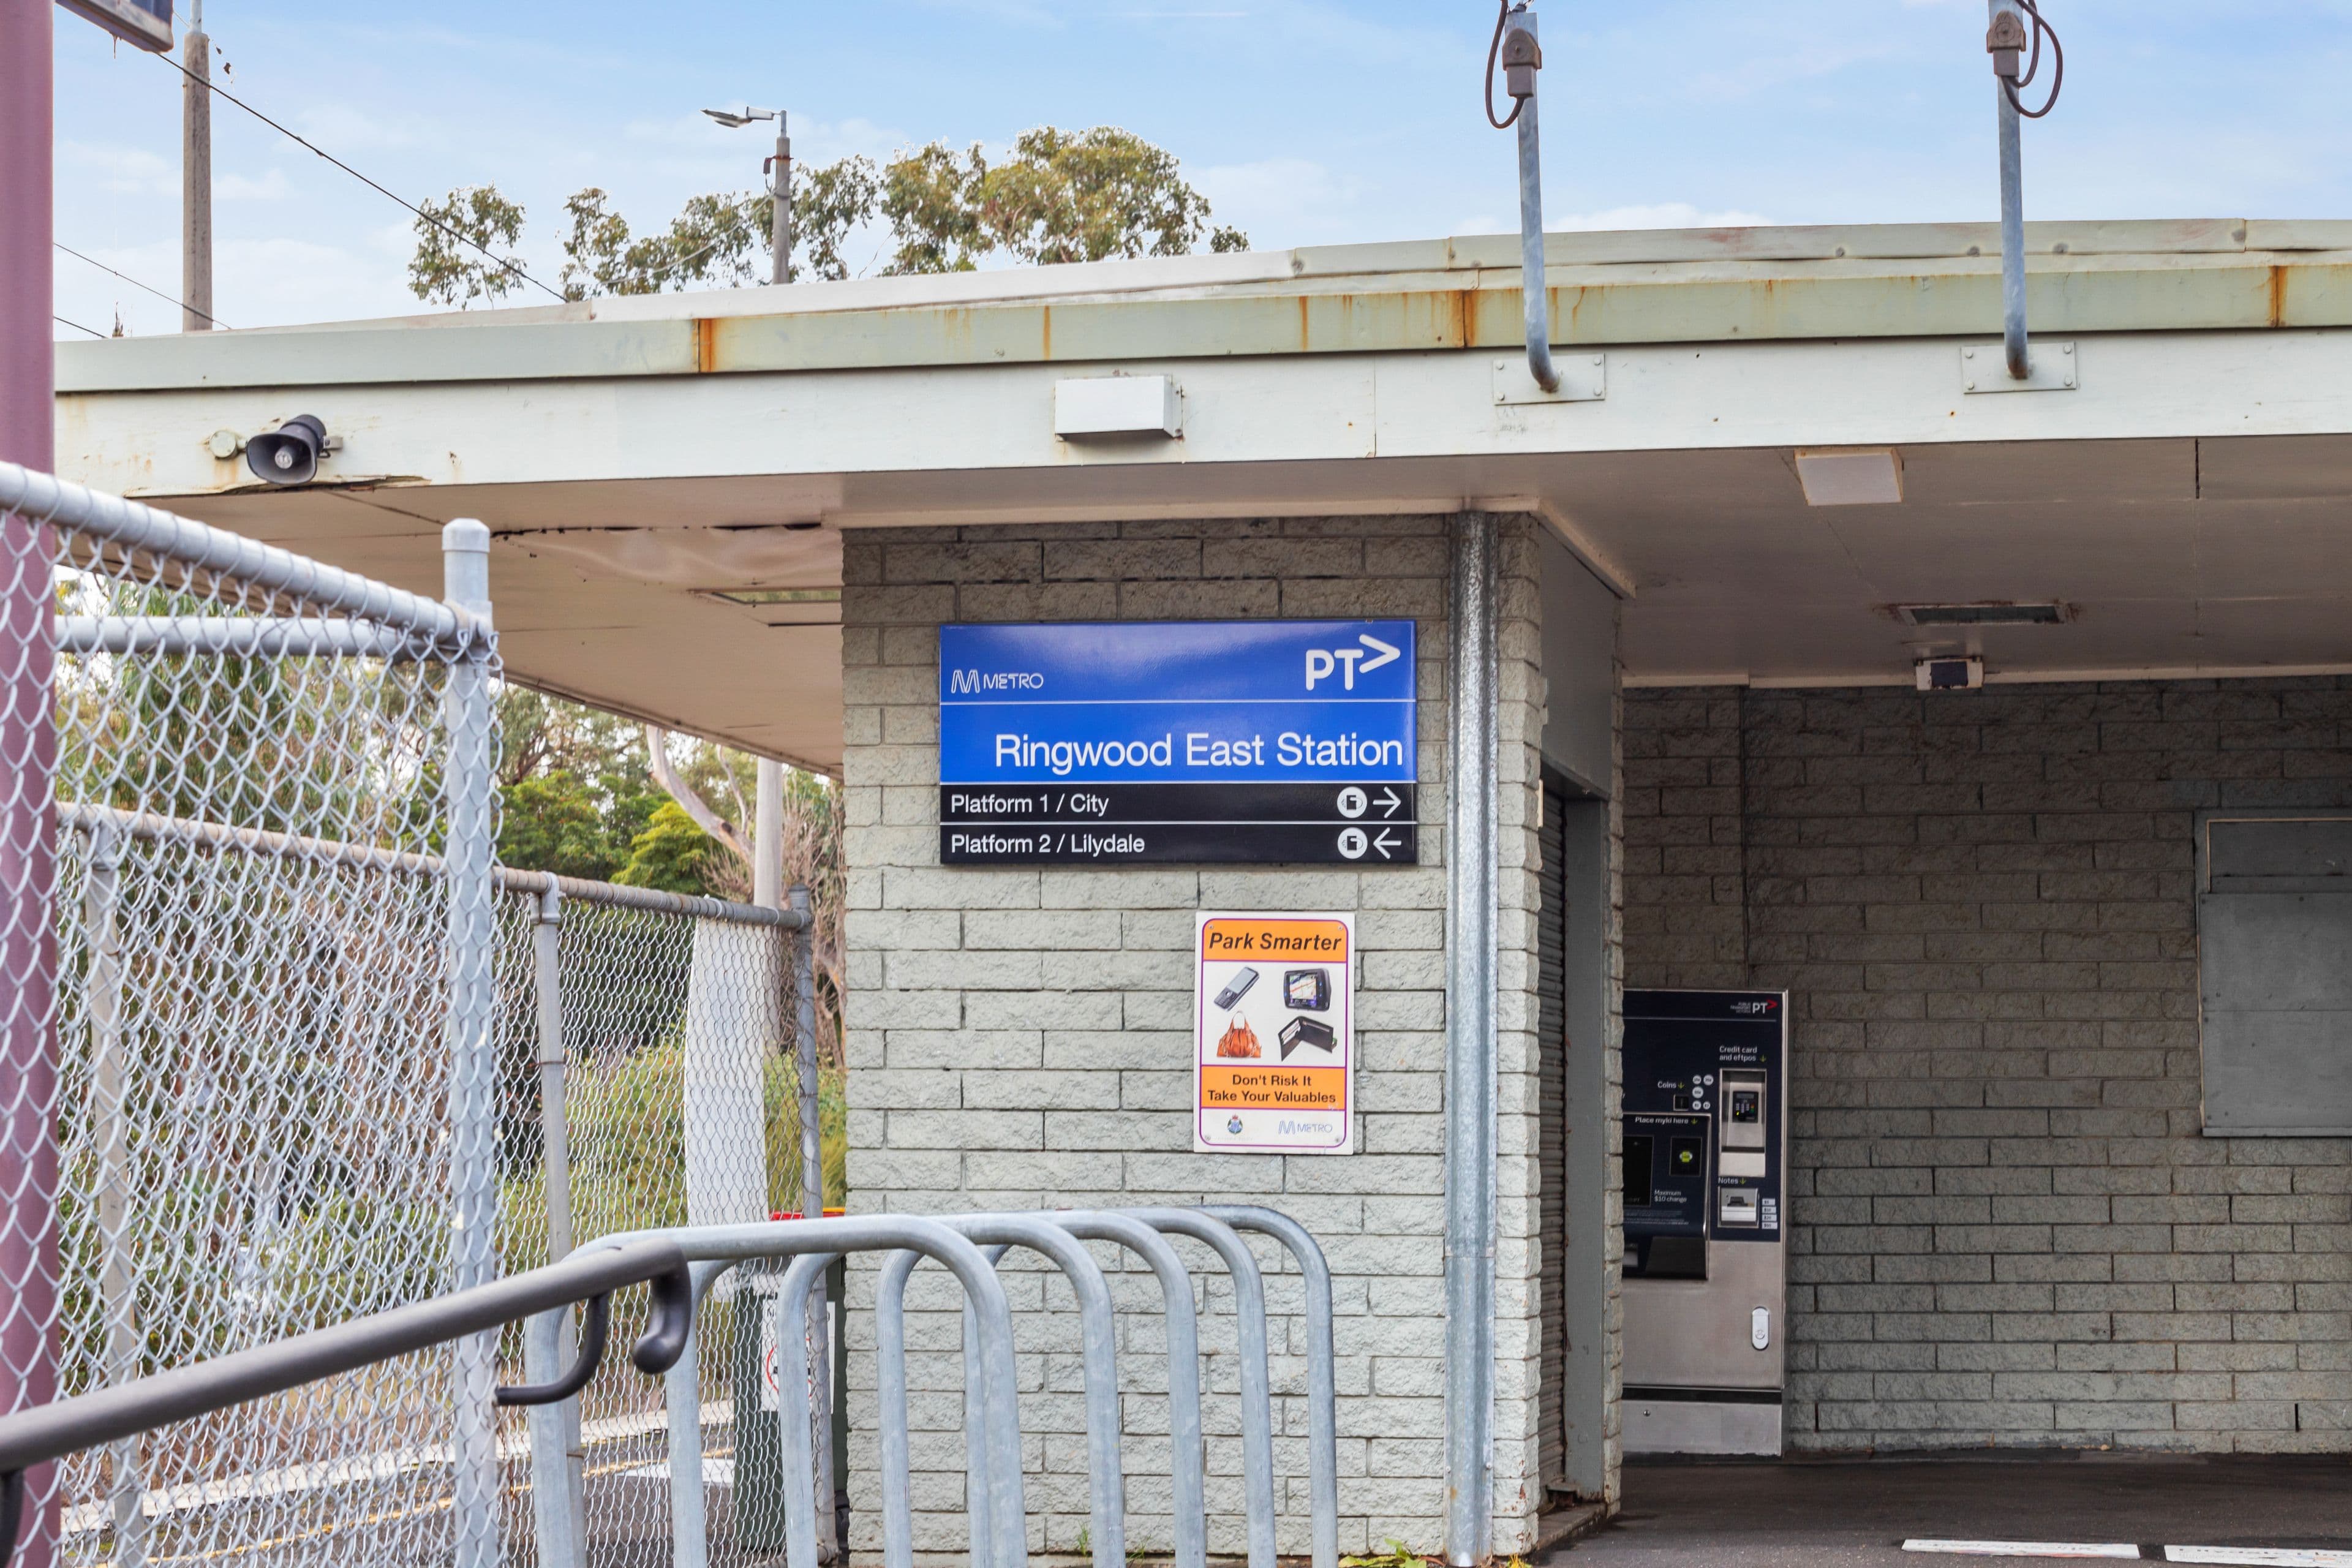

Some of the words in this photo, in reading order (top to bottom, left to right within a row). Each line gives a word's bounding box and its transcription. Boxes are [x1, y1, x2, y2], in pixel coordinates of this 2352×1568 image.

[982, 673, 1044, 689] METRO
[995, 733, 1172, 775] Ringwood
[1186, 732, 1265, 766] East
[1276, 731, 1403, 766] Station
[951, 794, 1033, 813] Platform
[1039, 794, 1047, 812] 1
[1055, 794, 1065, 813] /
[1071, 793, 1109, 816] City
[951, 834, 1033, 853] Platform
[1039, 834, 1051, 853] 2
[1056, 833, 1066, 853] /
[1071, 834, 1145, 857] Lilydale
[1209, 932, 1254, 950] Park
[1260, 933, 1341, 951] Smarter
[1733, 1054, 1757, 1063] eftpos
[1232, 1074, 1267, 1086] Don't
[1271, 1074, 1298, 1086] Risk
[1303, 1075, 1312, 1087] It
[1657, 1080, 1676, 1089] Coins
[1208, 1090, 1237, 1102] Take
[1242, 1090, 1270, 1102] Your
[1274, 1091, 1336, 1103] Valuables
[1297, 1123, 1333, 1133] METRO
